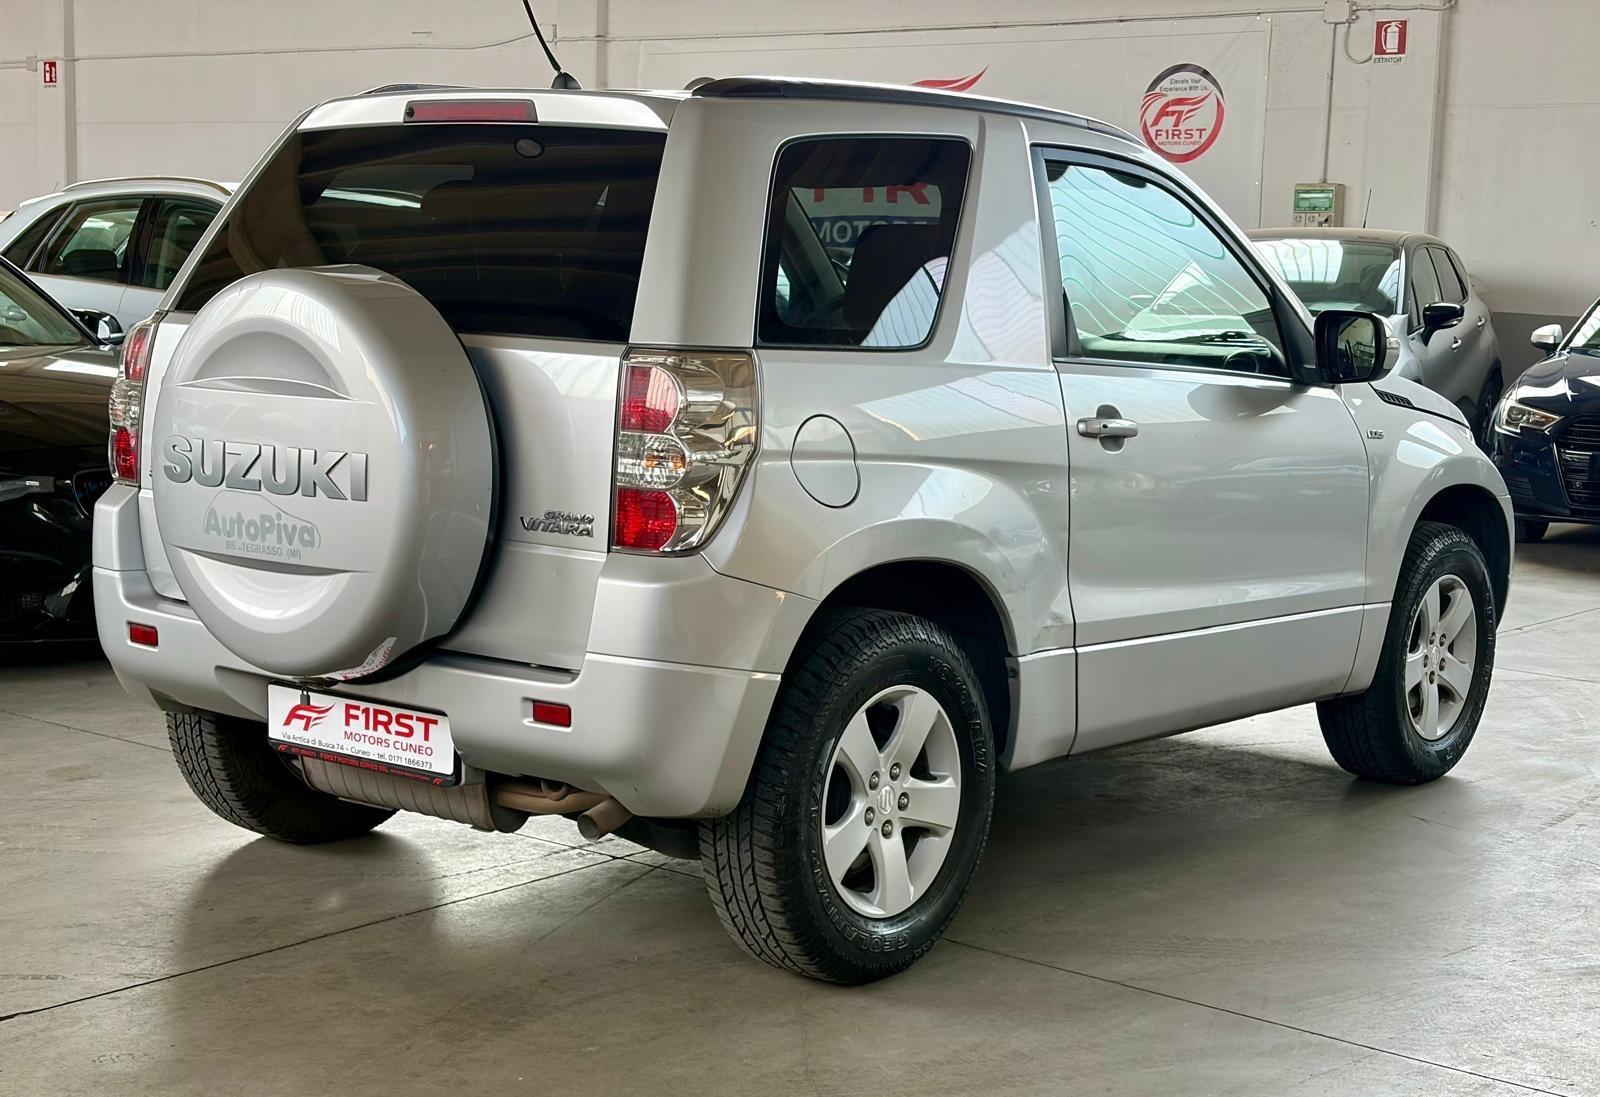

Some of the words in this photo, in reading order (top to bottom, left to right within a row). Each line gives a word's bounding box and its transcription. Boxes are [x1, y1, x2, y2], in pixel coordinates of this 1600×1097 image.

[163, 435, 369, 502] SUZUKI
[204, 507, 316, 548] AutoPiva
[520, 516, 594, 538] VITARA
[544, 510, 594, 525] GRAND
[225, 541, 283, 557] BBTEGRASSO
[281, 731, 291, 740] Via
[292, 734, 310, 745] Antica
[311, 737, 317, 746] di
[318, 739, 335, 750] Busca
[336, 743, 344, 751] 74
[350, 746, 371, 757] Cuneo
[377, 752, 387, 761] tel.
[388, 754, 403, 763] 0171
[404, 757, 433, 769] 1866373
[344, 730, 390, 748] MOTORS
[393, 740, 433, 757] CUNEO
